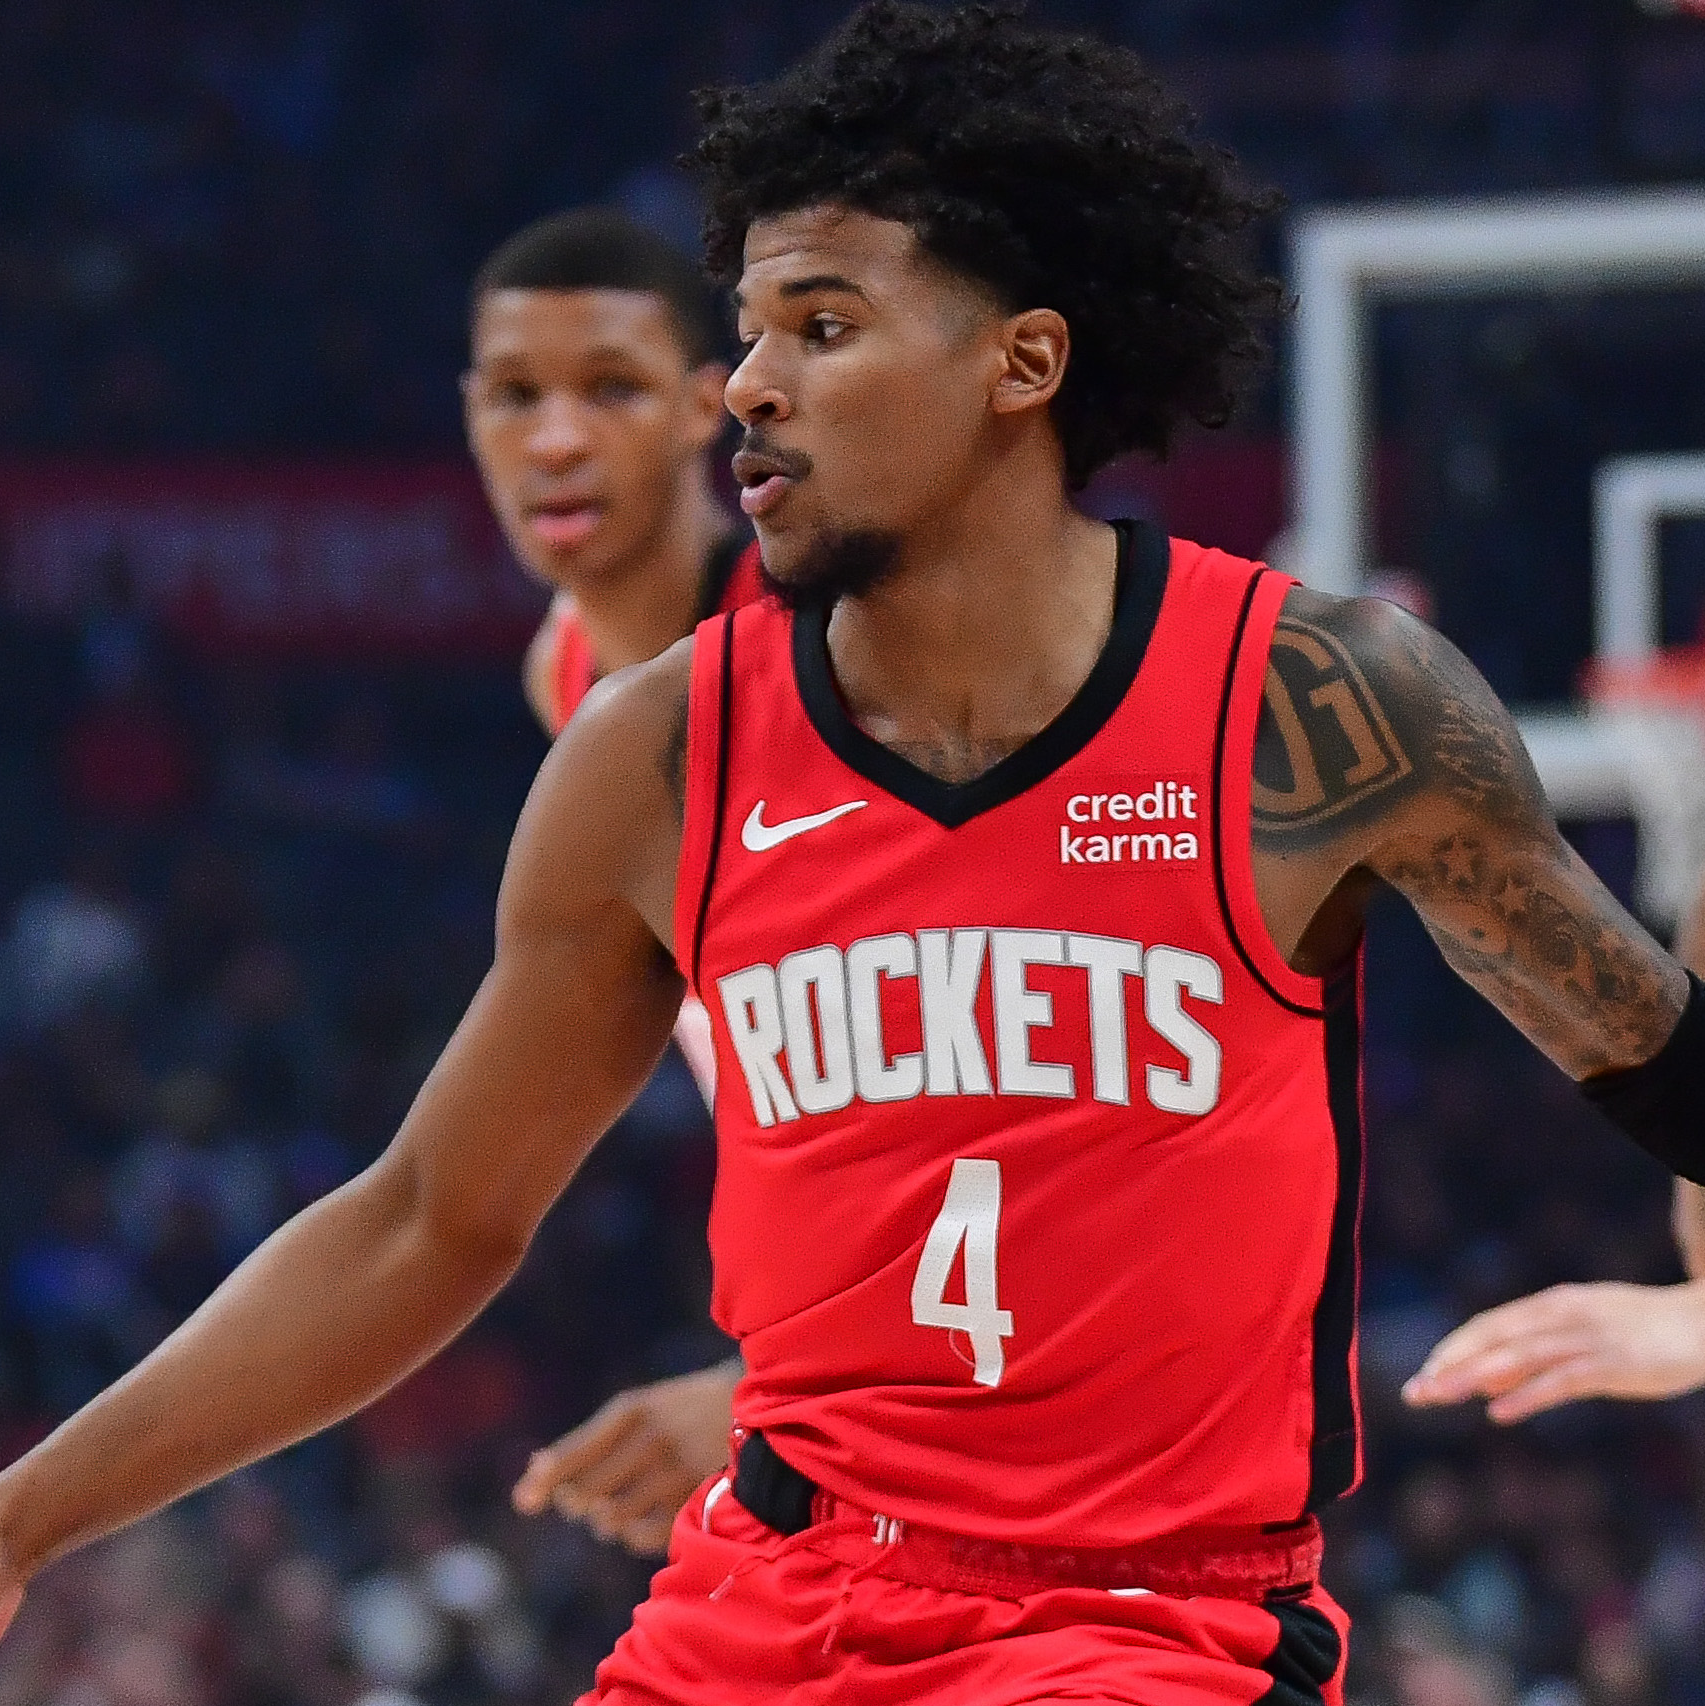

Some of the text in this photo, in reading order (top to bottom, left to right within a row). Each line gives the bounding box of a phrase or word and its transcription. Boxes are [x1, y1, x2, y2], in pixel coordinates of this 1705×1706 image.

[1059, 826, 1199, 865] karma
[1065, 780, 1198, 824] credit
[717, 926, 1224, 1129] ROCKETS
[911, 1157, 1014, 1387] 4
